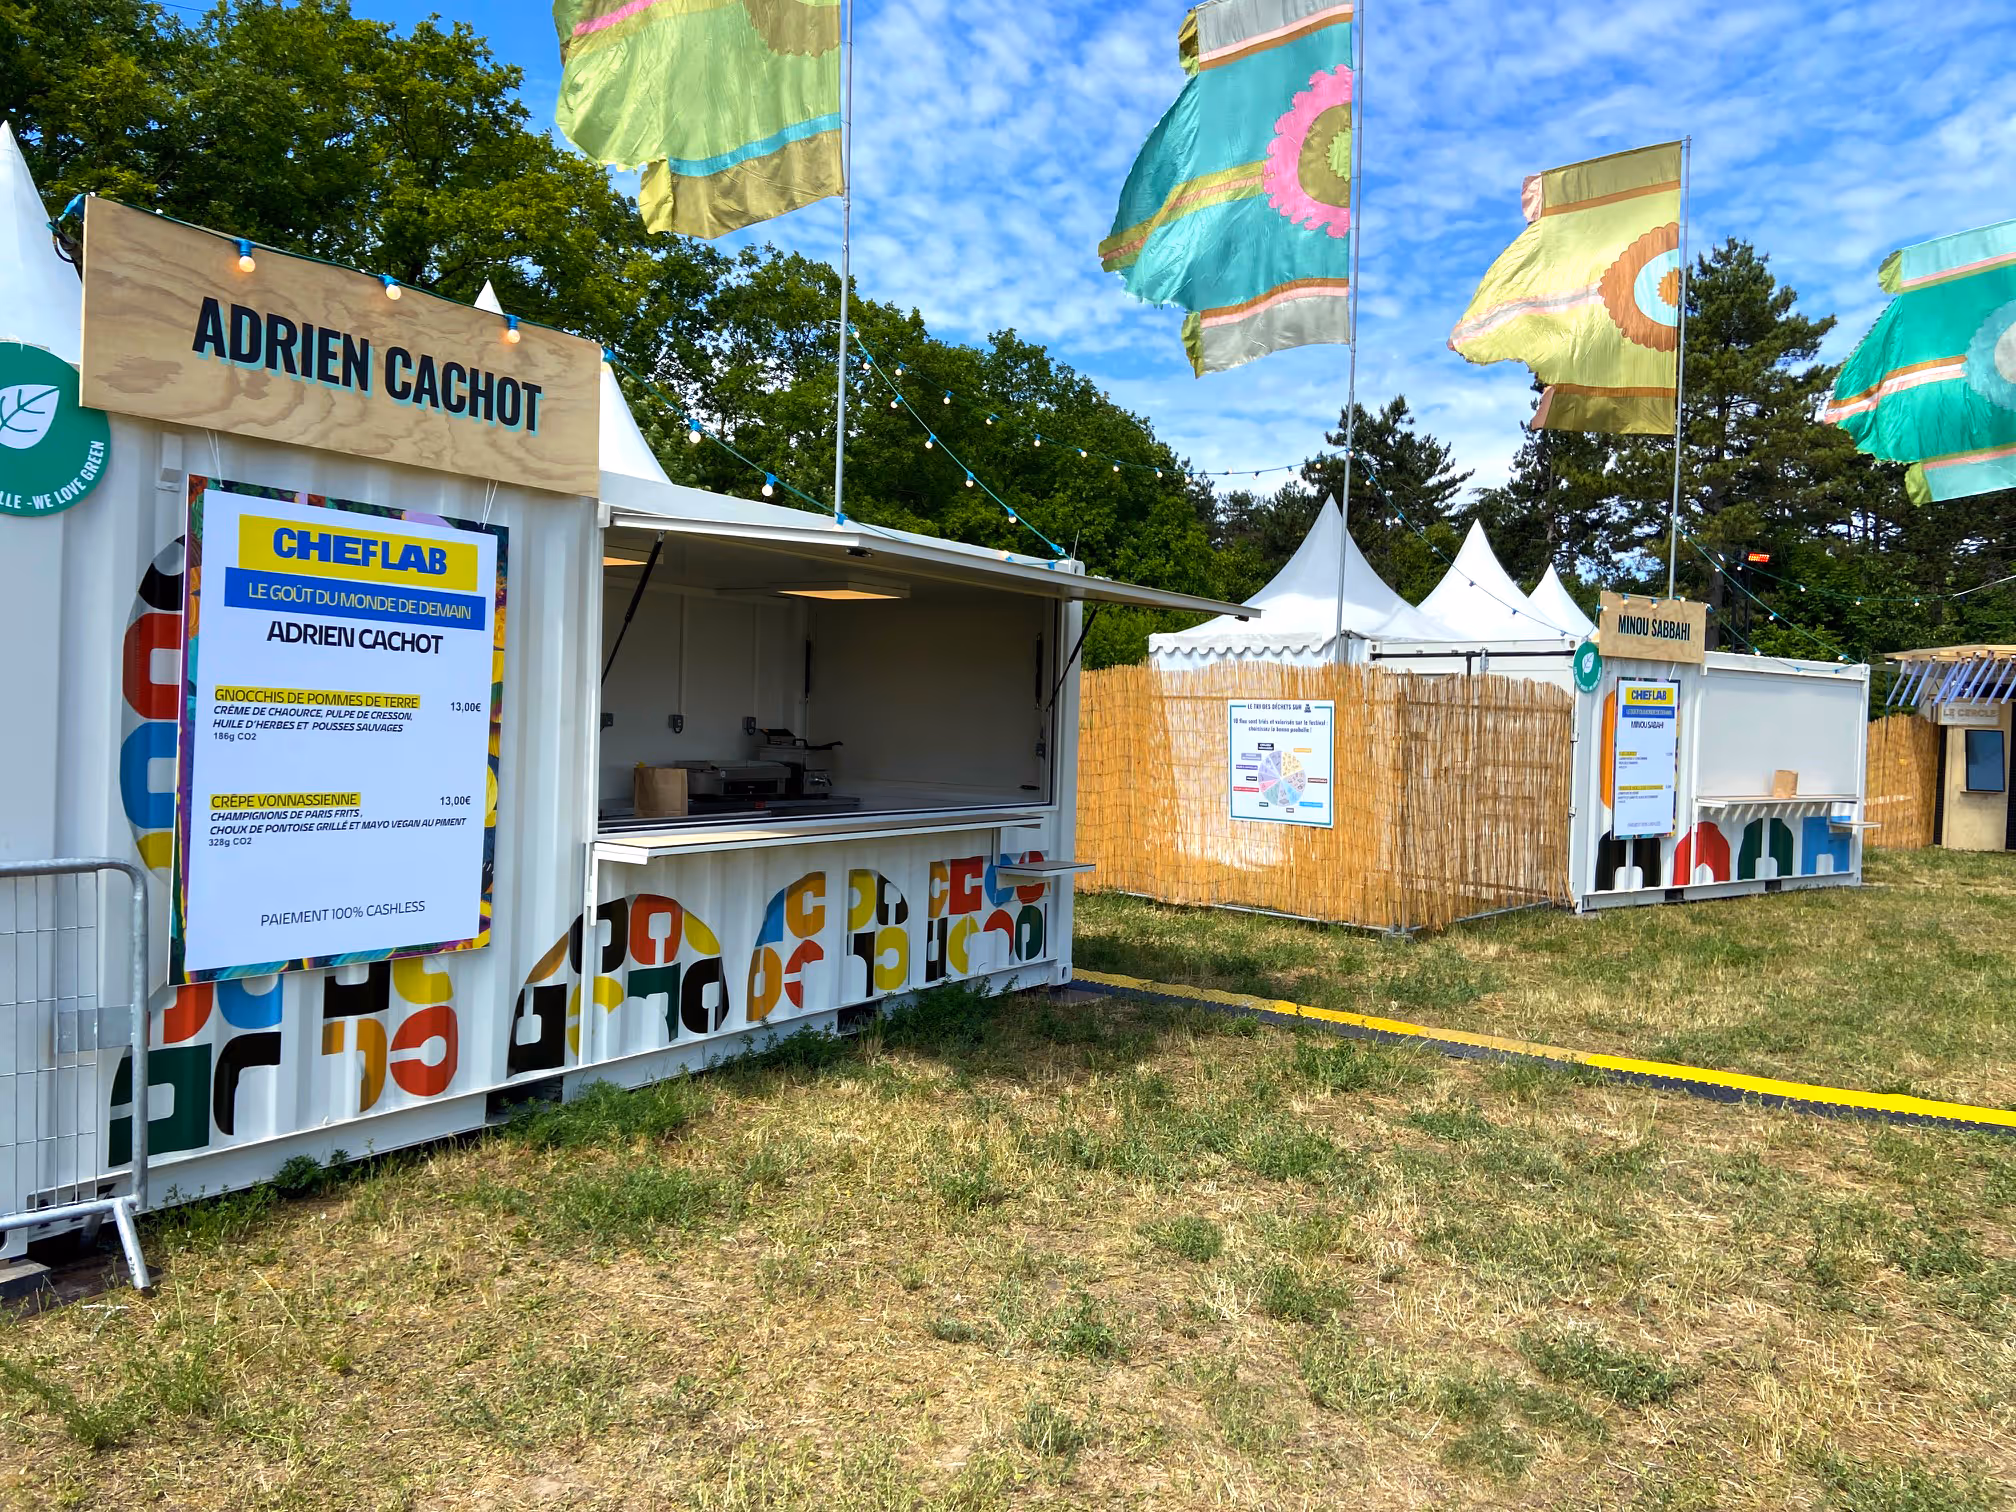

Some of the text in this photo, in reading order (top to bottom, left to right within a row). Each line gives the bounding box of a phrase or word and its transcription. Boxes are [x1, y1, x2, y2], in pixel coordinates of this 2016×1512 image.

[192, 296, 542, 433] ADRIEN CACHOT
[54, 477, 87, 505] LOVE
[80, 440, 105, 481] GREEN
[272, 527, 447, 575] CHEFLAB
[248, 582, 471, 620] LE GOÛT DU MONDE DE DEMAIN
[1618, 614, 1691, 641] MINOU SABBAHI
[267, 621, 444, 654] ADRIEN CACHOT
[215, 689, 418, 708] GNOCCHIS DE POMMES DE TERRE
[1631, 690, 1667, 701] CHEFLAB
[252, 707, 267, 716] DE
[268, 707, 323, 718] CHAOURCE,
[325, 709, 355, 719] PULPE
[357, 711, 370, 719] DE
[371, 711, 413, 721] CRESSON,
[450, 702, 481, 713] 13,00€
[213, 719, 403, 732] HUILE D'HERBES ET POUSSES SAUVAGES
[213, 732, 257, 742] 186g CO2
[212, 793, 357, 808] CRÊPE VONNASSIENNE
[440, 796, 471, 807] 13,00€
[210, 811, 288, 821] CHAMPIGNONS
[290, 810, 304, 819] DE
[305, 809, 333, 818] PARIS
[210, 817, 467, 835] CHOUX DE PONTOISE GRILLÉ ET MAYO VEGAN AU PIMENT
[209, 837, 252, 847] 328g CO2
[261, 900, 426, 927] PAIEMENT 100% CASHLESS
